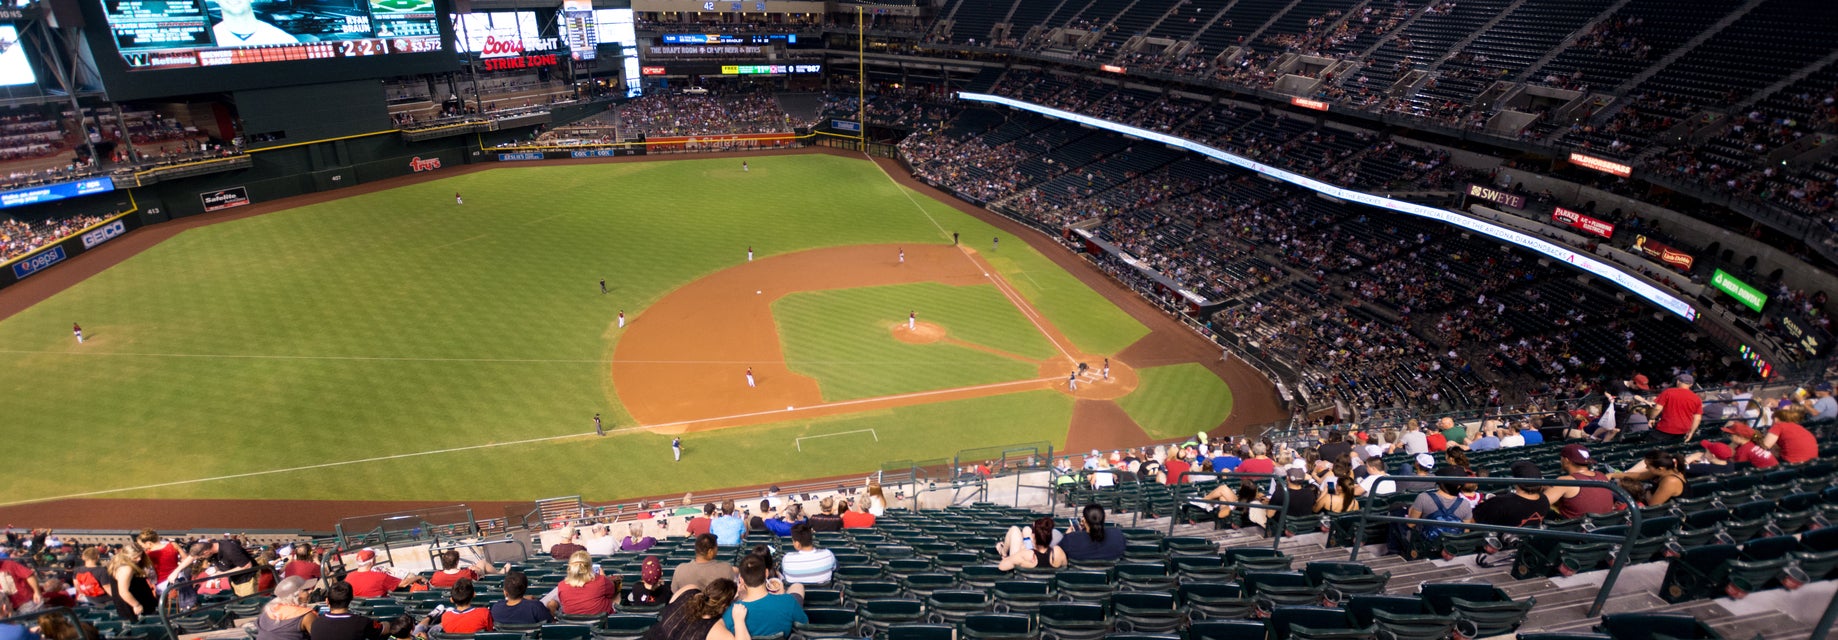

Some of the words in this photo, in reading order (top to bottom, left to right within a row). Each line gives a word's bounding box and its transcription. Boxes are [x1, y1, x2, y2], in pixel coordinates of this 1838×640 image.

[704, 2, 714, 10] 42
[345, 16, 369, 24] RYAN
[342, 24, 371, 33] BRAUN
[342, 40, 356, 56] 2
[361, 40, 374, 56] 2
[380, 38, 389, 54] 1
[412, 41, 442, 52] $3,572
[483, 36, 524, 54] Coors
[524, 38, 558, 52] LIGHT
[152, 57, 196, 66] Refining
[485, 56, 526, 71] STRIKE
[527, 54, 557, 67] ZONE
[205, 193, 236, 203] Safelite
[1554, 208, 1580, 222] PARKER
[82, 220, 126, 248] GEICO
[1414, 208, 1444, 220] OFFICIAL
[1446, 214, 1461, 222] BEER
[1472, 221, 1484, 230] THE
[1485, 226, 1513, 241] ARIZONA
[1515, 235, 1567, 259] DIAMONDBACKS
[32, 251, 58, 270] pepsi
[1738, 287, 1761, 307] DENTAL
